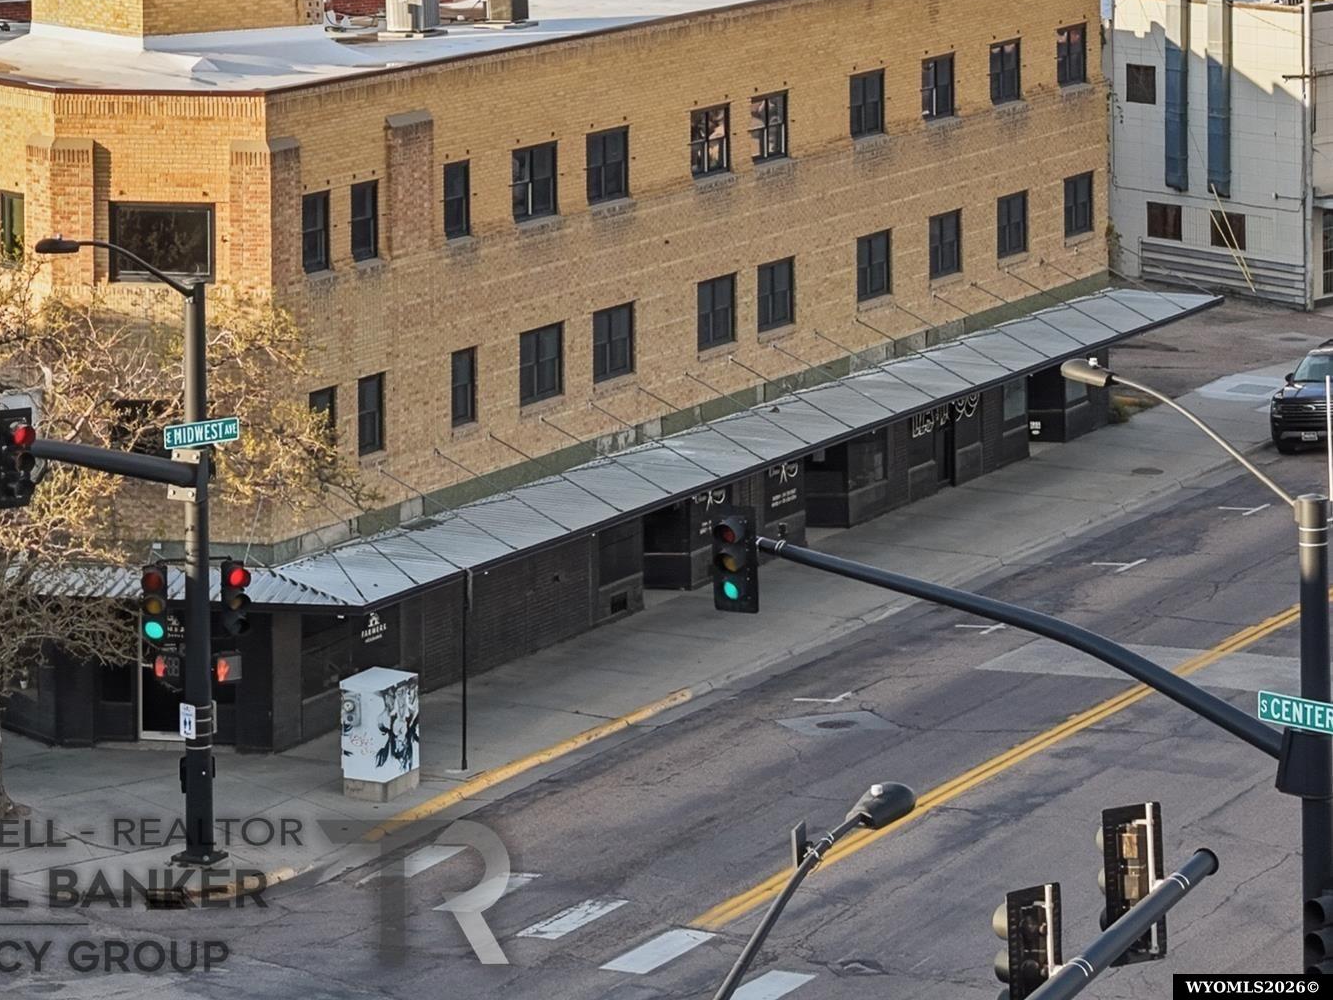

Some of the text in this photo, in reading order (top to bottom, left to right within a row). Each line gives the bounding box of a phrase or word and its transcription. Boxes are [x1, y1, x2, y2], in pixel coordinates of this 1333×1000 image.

[166, 421, 238, 445] E MIDWEST AVE
[1260, 697, 1333, 729] S CENTER
